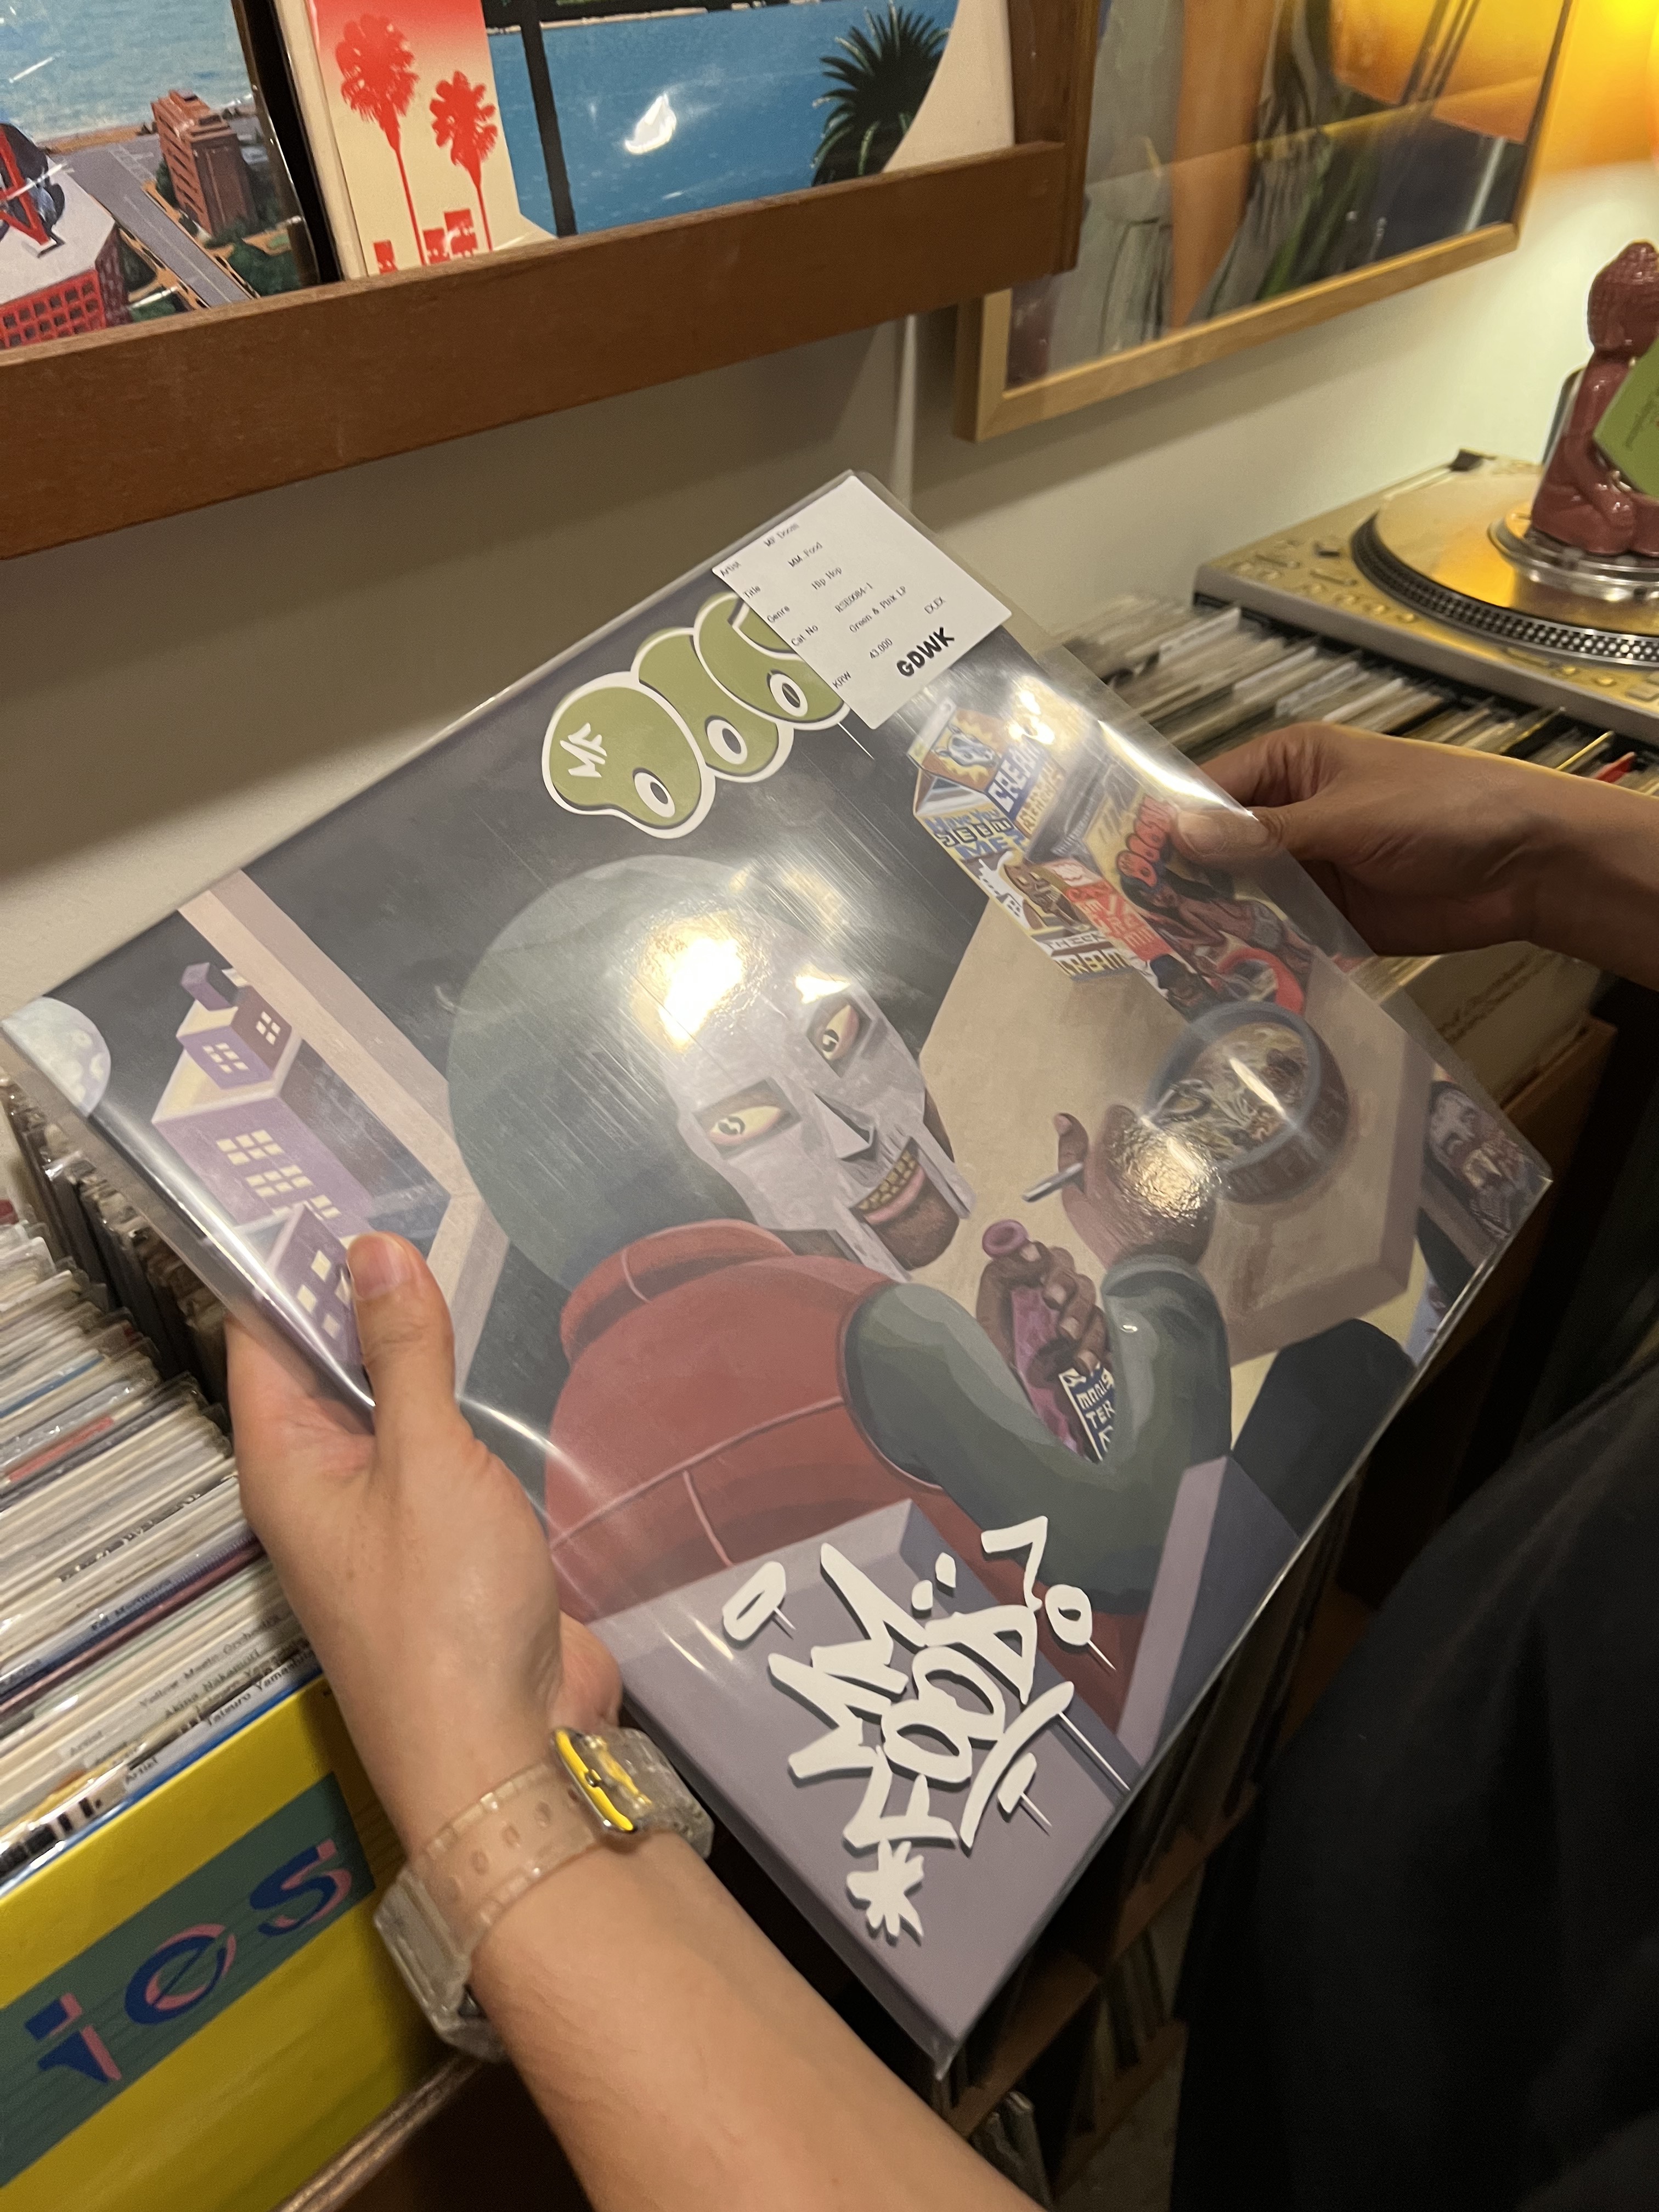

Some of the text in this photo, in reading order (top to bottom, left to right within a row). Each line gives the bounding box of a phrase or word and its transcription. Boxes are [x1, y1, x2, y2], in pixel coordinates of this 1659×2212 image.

[743, 585, 761, 599] Title
[767, 566, 842, 623] Genre Hip Hop
[849, 614, 872, 633] Green
[879, 594, 897, 610] Pink
[896, 585, 906, 597] LP
[791, 634, 806, 646] Cat
[805, 625, 819, 636] No
[896, 627, 955, 677] GDWK
[832, 670, 851, 689] KRW
[560, 723, 607, 777] MF
